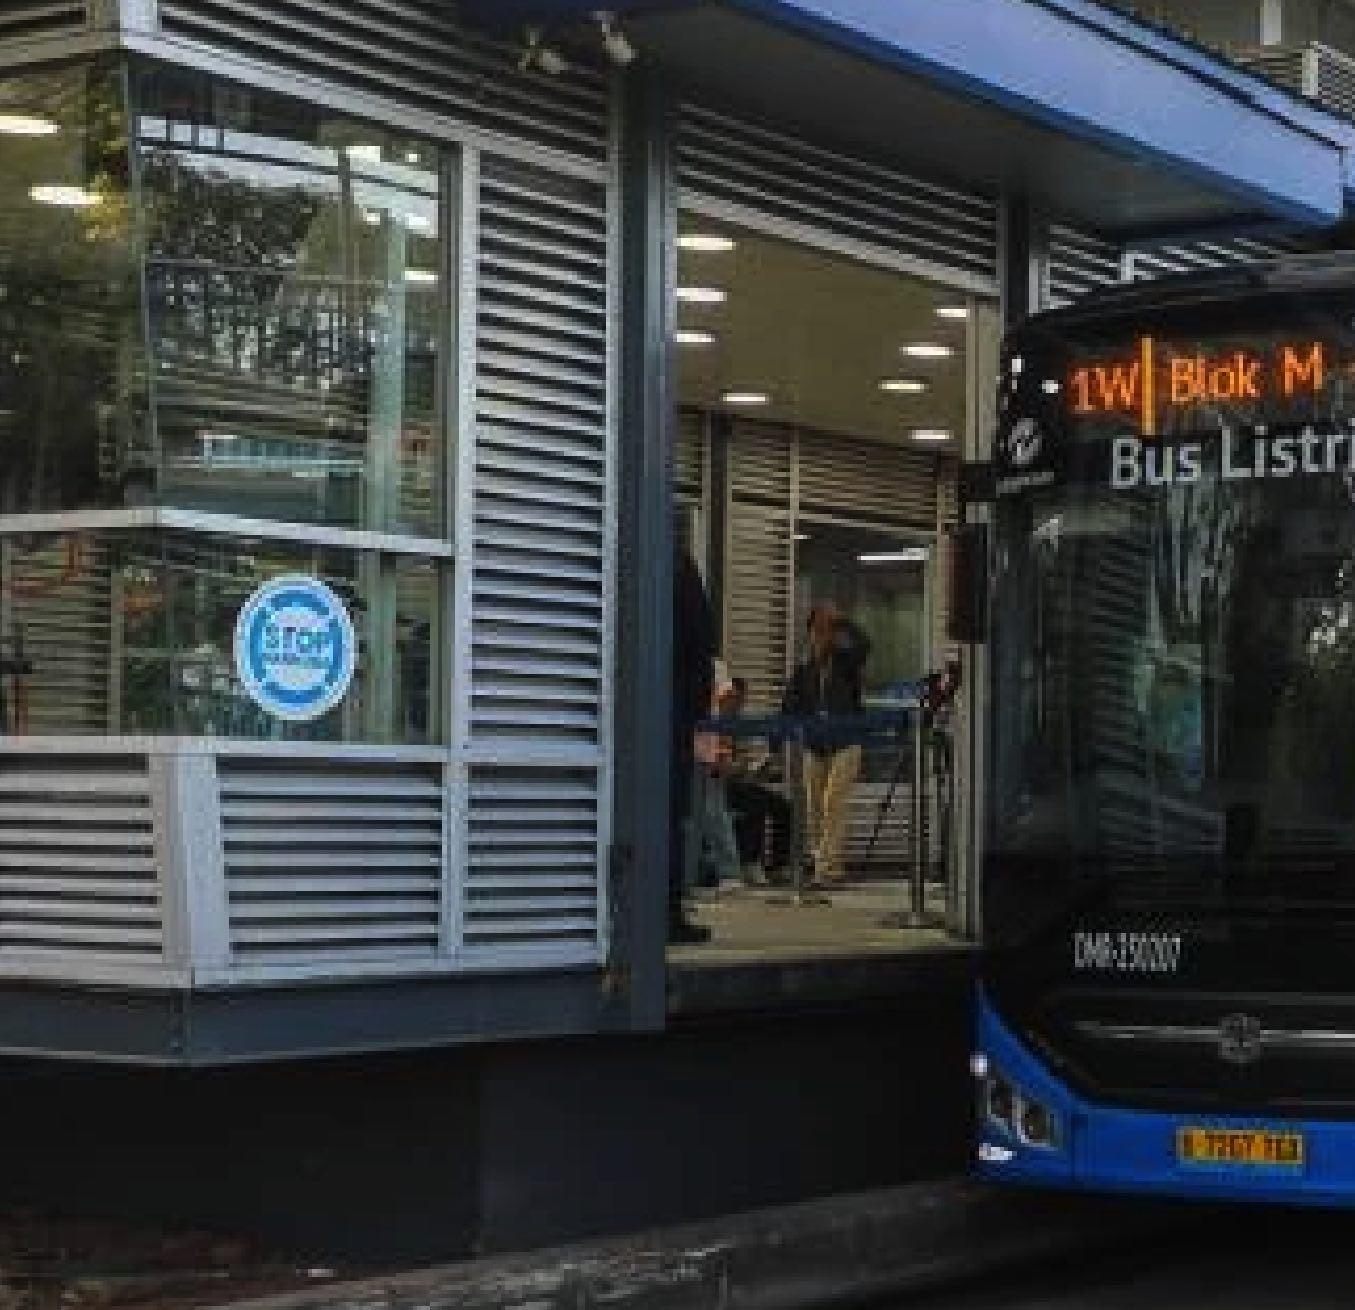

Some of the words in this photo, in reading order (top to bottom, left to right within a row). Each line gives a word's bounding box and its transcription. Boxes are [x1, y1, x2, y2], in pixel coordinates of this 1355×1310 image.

[1071, 361, 1140, 413] 1W
[1171, 353, 1262, 403] Blok
[1284, 341, 1323, 395] M
[1112, 436, 1202, 489] Bus
[265, 625, 330, 654] STOP
